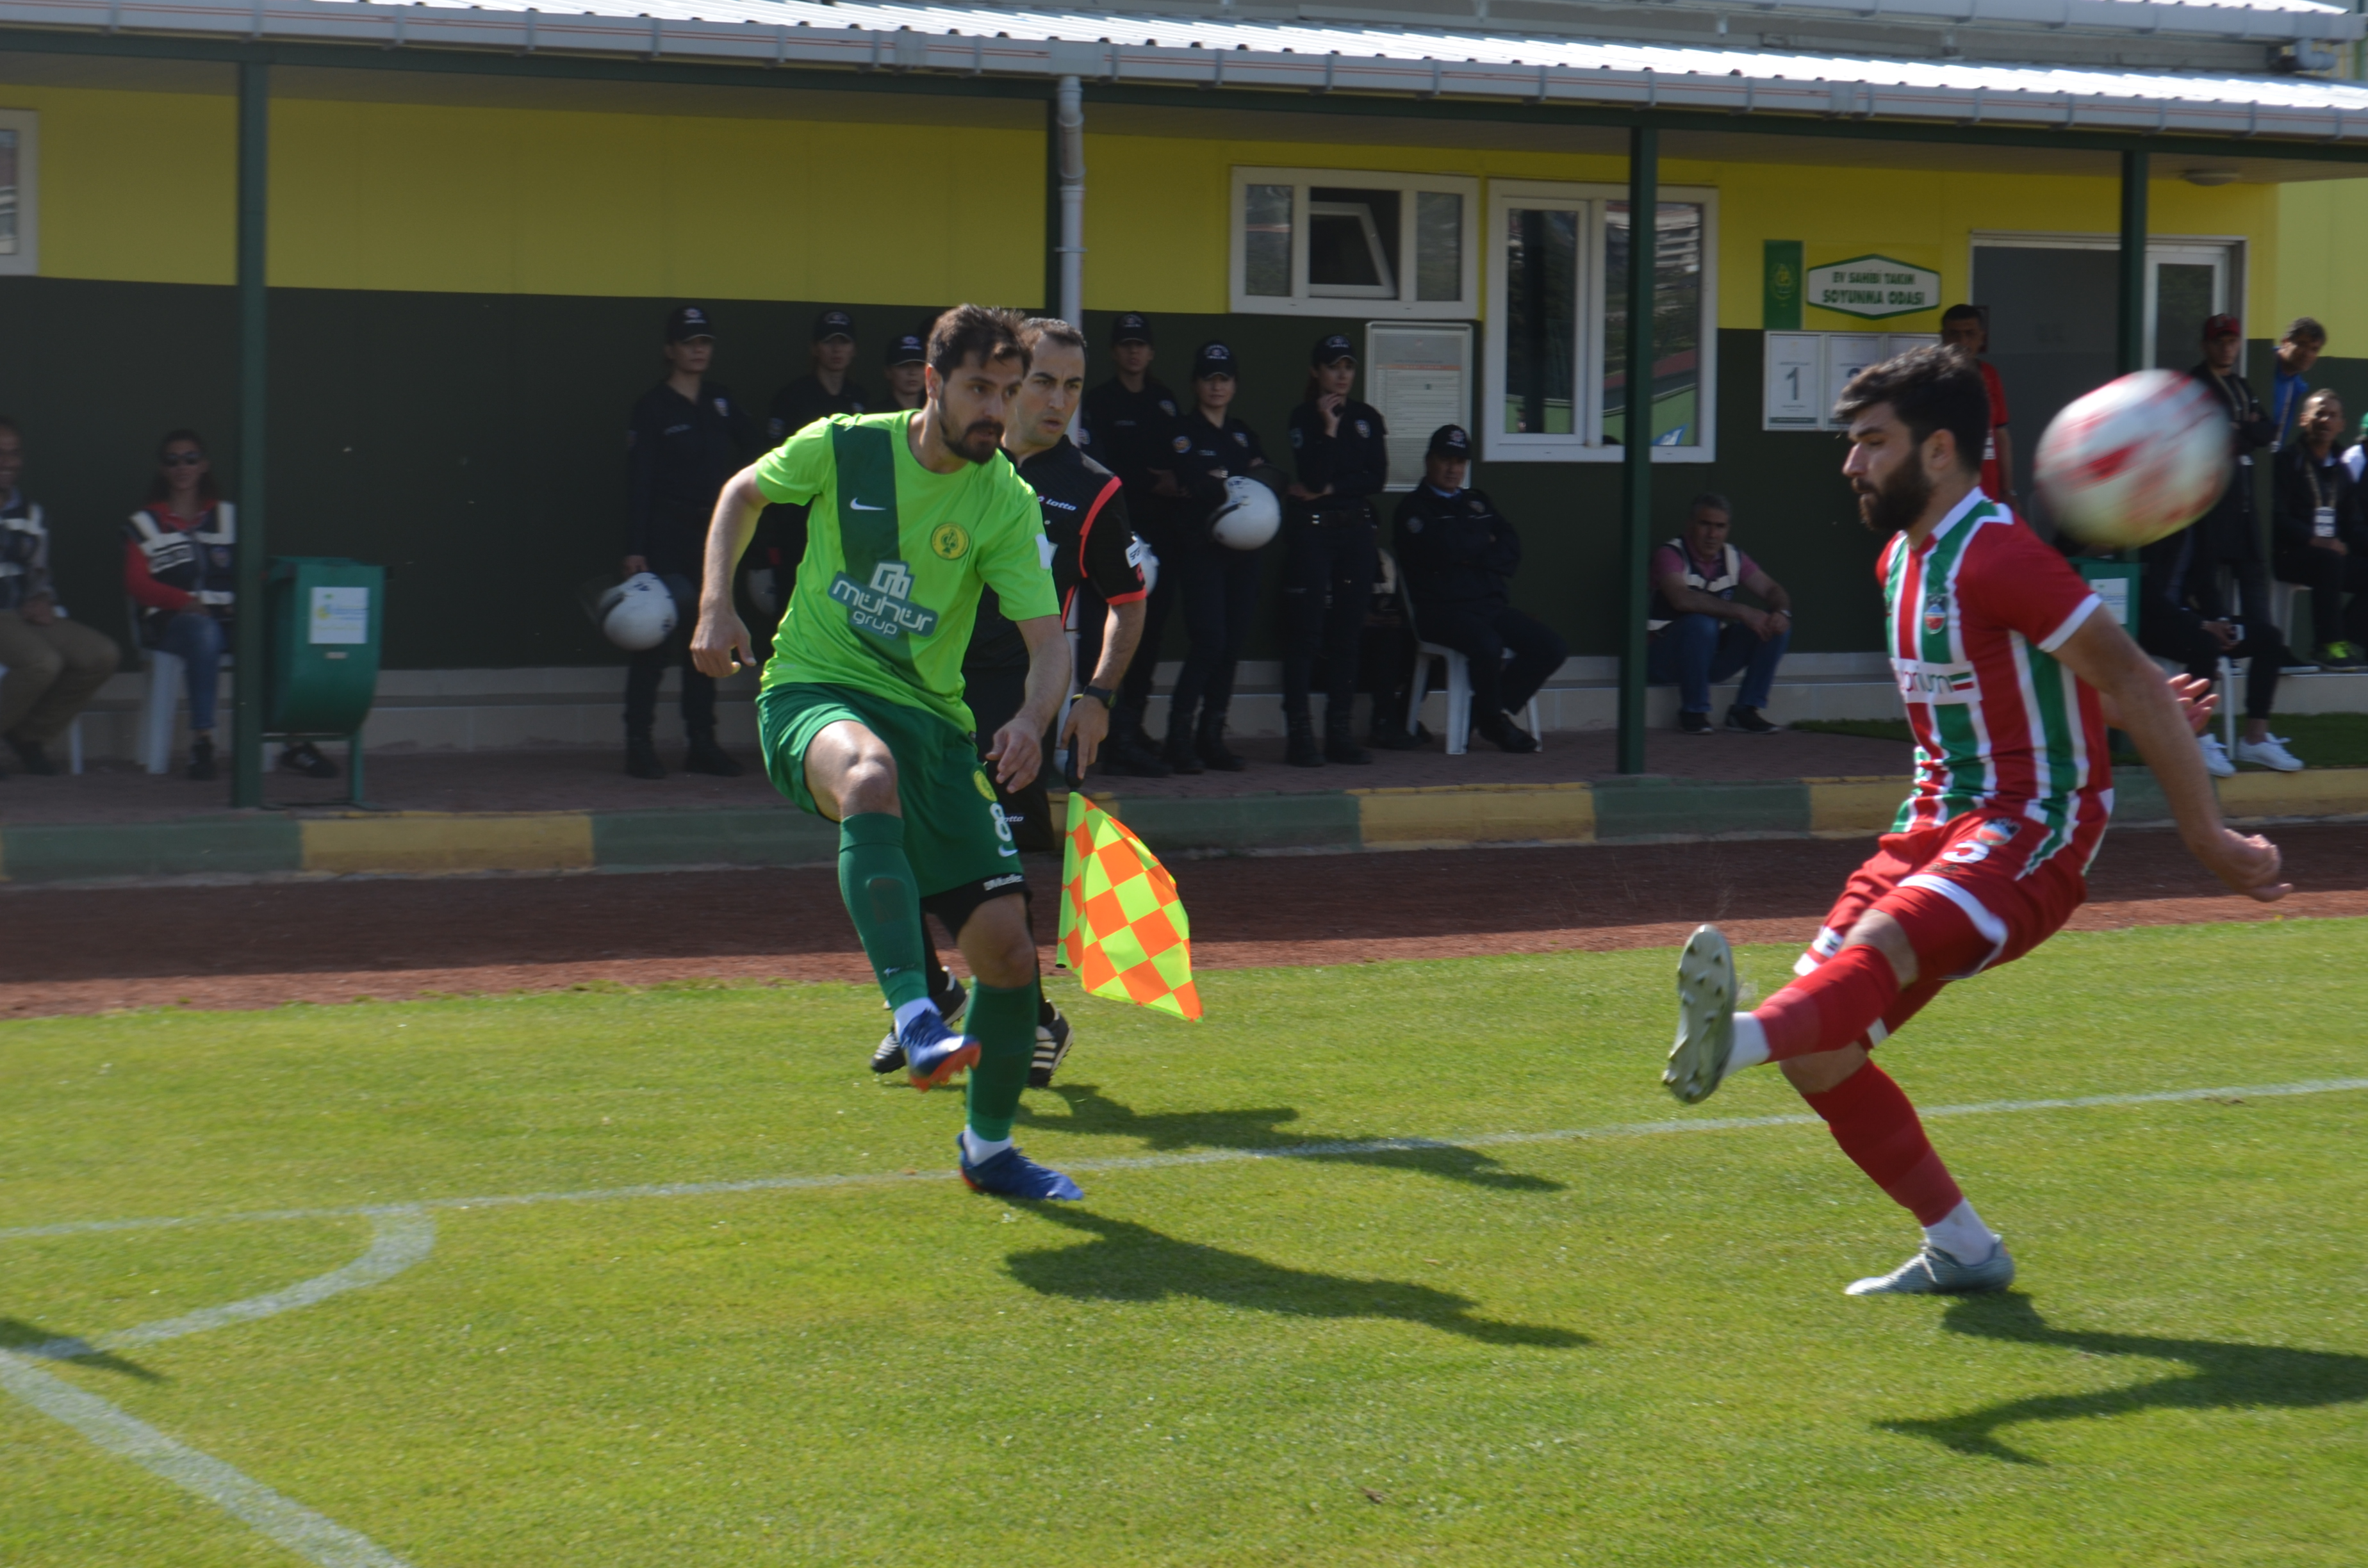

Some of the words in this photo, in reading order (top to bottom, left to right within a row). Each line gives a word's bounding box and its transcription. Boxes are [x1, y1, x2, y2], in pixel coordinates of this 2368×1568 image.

[1832, 272, 1846, 283] EV
[1823, 290, 1884, 304] SOYUNMA
[1888, 291, 1925, 306] ODASI
[1785, 366, 1800, 401] 1
[853, 610, 898, 635] grup
[989, 803, 1012, 842] 8
